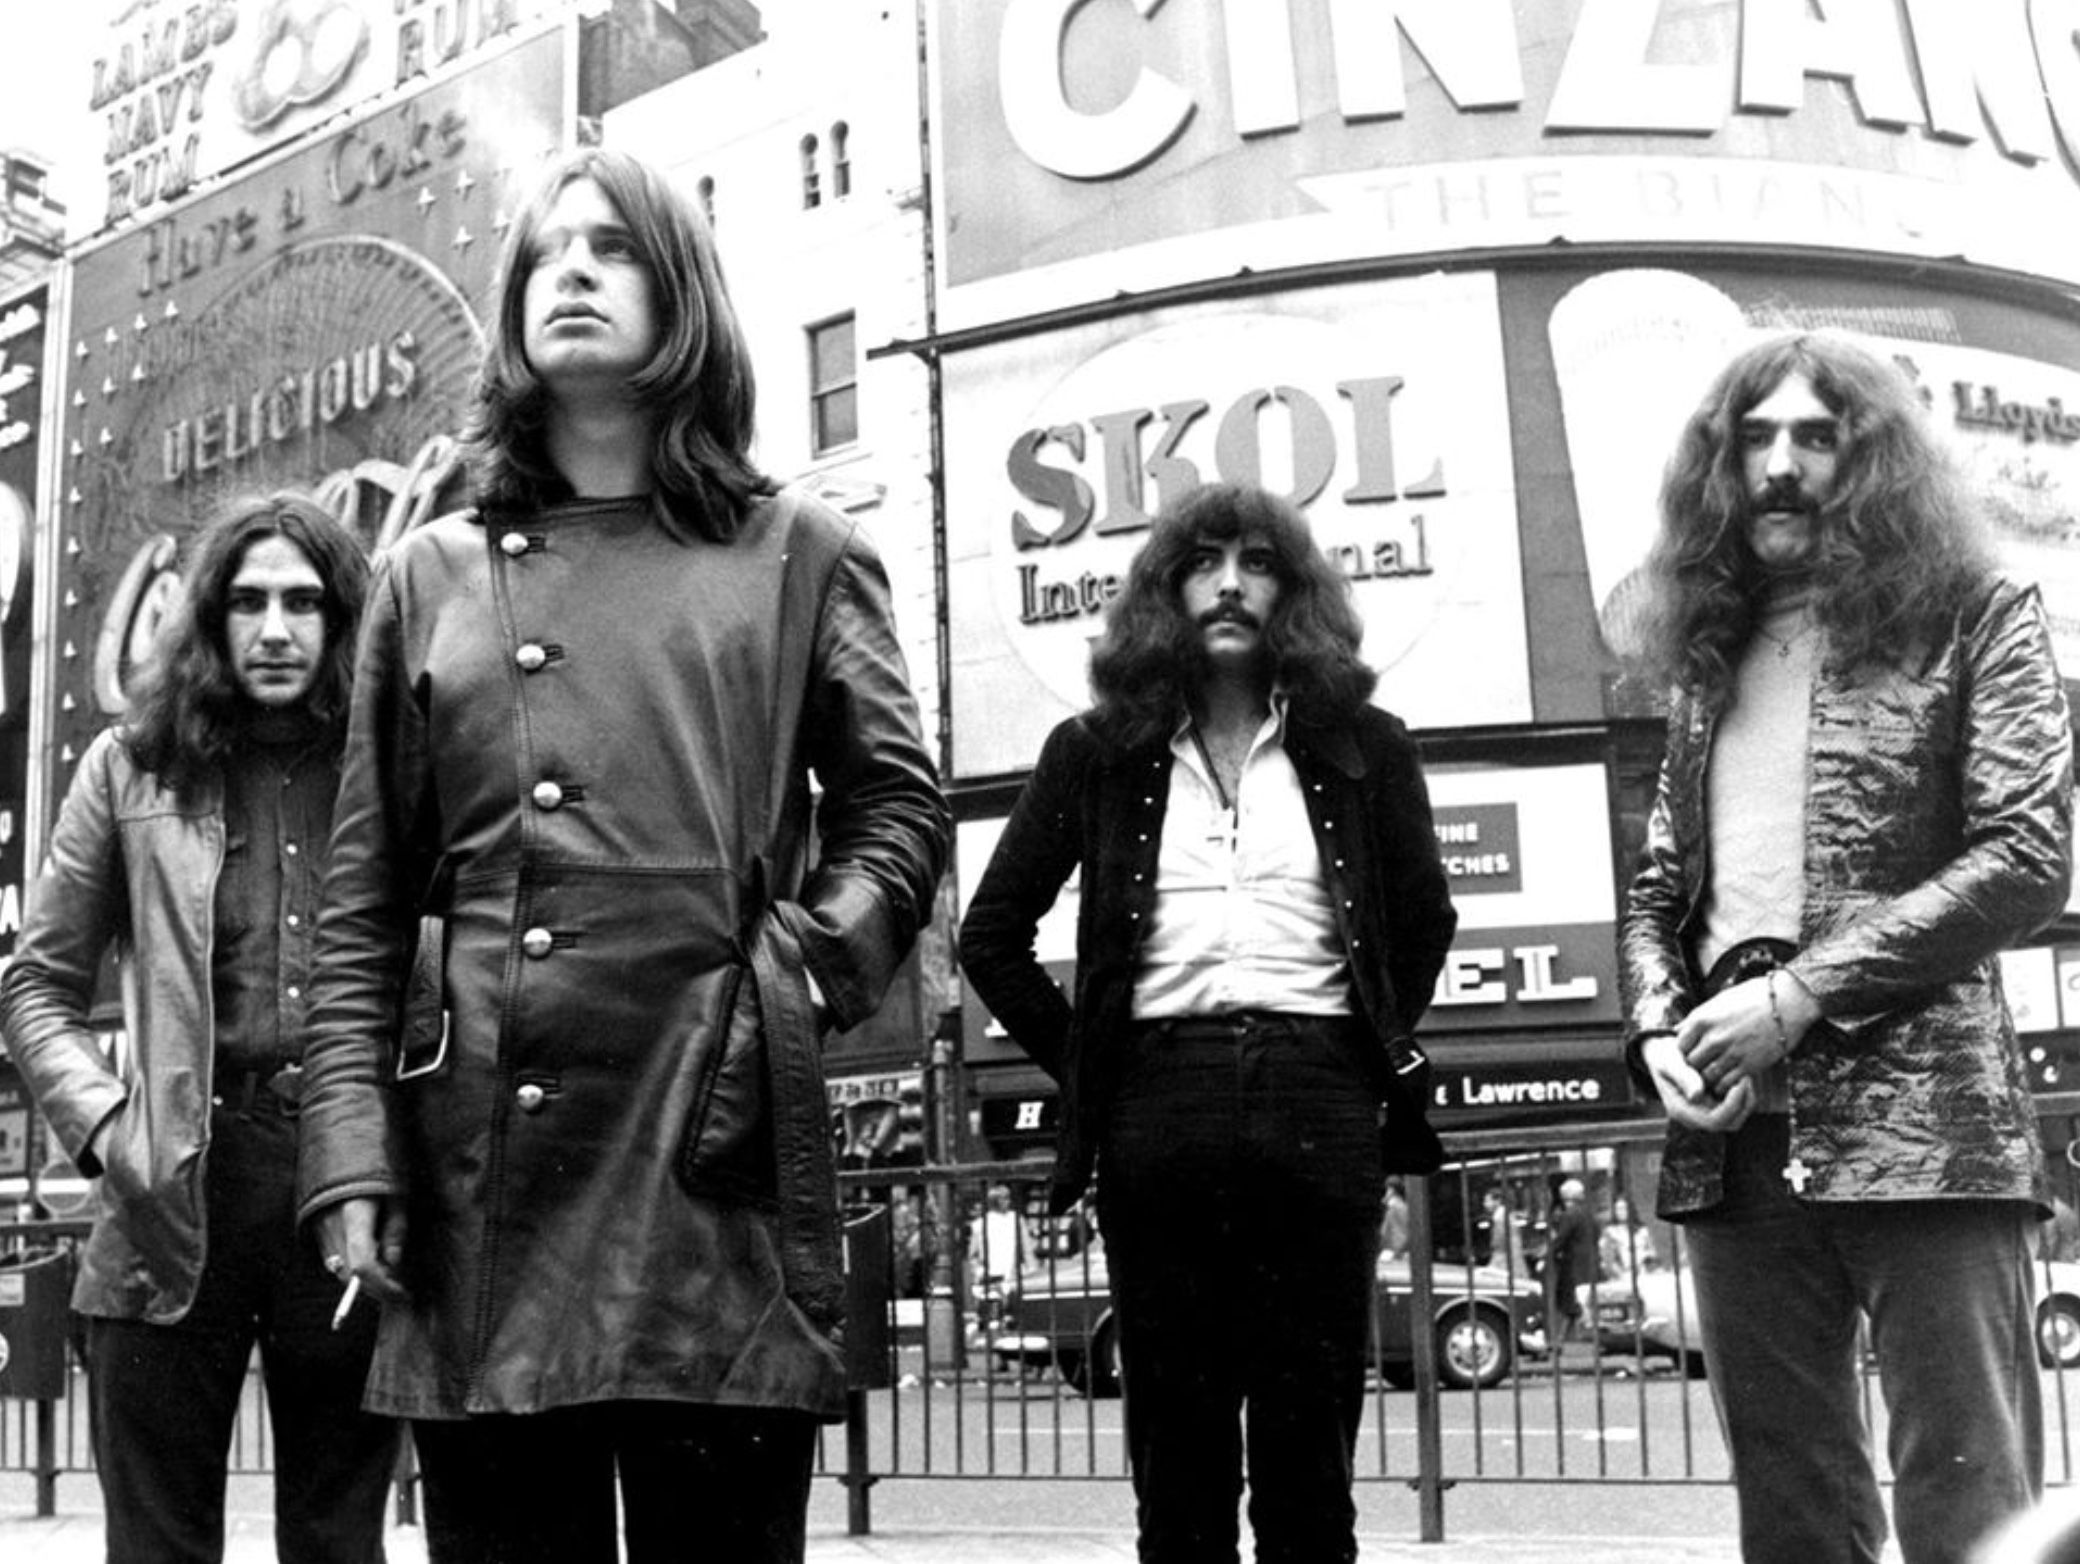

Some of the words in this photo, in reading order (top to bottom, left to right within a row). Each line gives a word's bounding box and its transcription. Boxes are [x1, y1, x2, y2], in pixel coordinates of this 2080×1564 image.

[103, 60, 214, 166] NAVY
[1363, 170, 1570, 231] THE
[1637, 170, 1923, 238] BIAN
[162, 331, 416, 482] DELICIOUS
[1007, 376, 1447, 551] SKOL
[1462, 1075, 1600, 1105] Lawrence
